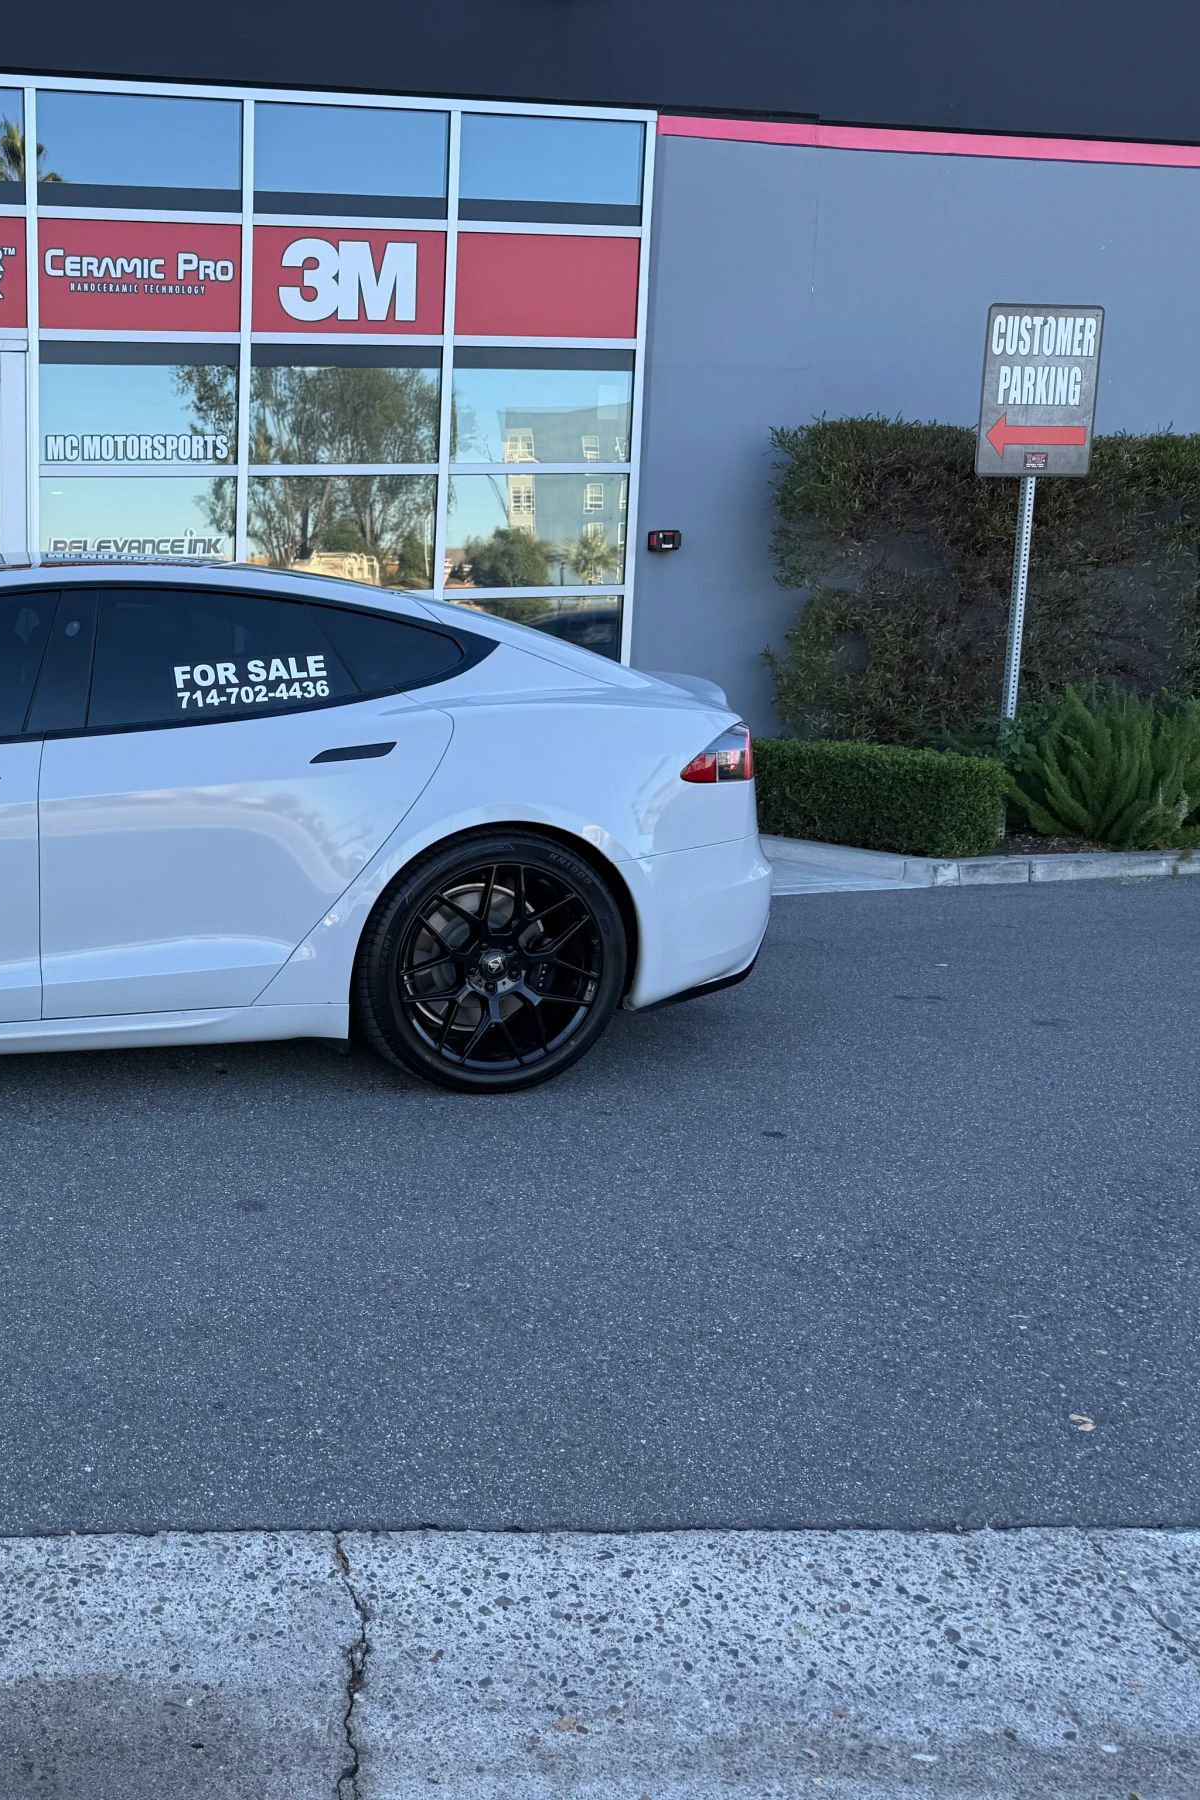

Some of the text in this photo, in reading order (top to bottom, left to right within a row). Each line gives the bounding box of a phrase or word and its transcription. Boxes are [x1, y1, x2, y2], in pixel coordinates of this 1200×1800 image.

[69, 281, 206, 295] NANOCERAMIC TECHNOLOGY
[278, 236, 418, 322] 3M
[991, 314, 1097, 357] CUSTOMER
[997, 365, 1082, 407] PARKING
[46, 433, 229, 462] MC MOTORSPORTS
[173, 655, 328, 689] FOR SALE
[177, 680, 330, 709] 714-702-4436
